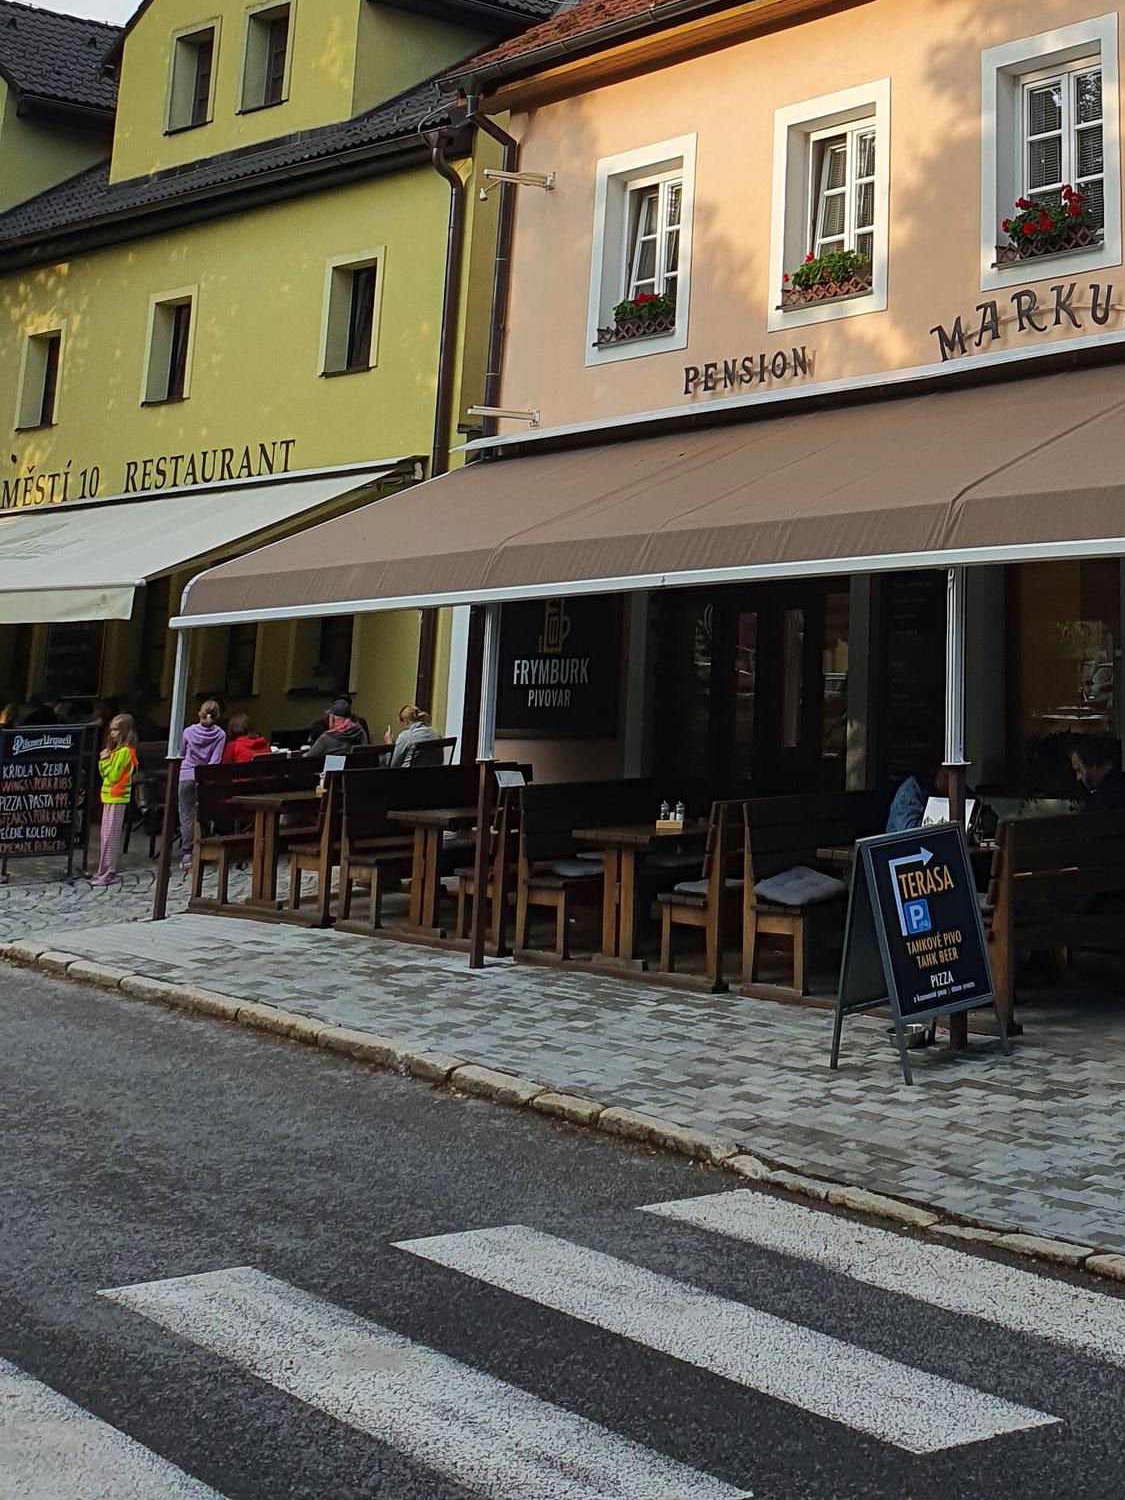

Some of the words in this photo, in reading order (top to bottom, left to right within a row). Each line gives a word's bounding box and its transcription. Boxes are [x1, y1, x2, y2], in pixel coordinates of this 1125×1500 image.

[684, 346, 807, 395] PENSION
[78, 466, 99, 500] 10
[122, 438, 296, 494] RESTAURANT
[513, 657, 590, 685] FRYMBURK
[528, 689, 571, 707] PIVOVAR
[43, 733, 73, 750] Urquell
[898, 864, 955, 900] TERASA
[906, 931, 943, 956] TANKOVÉ
[942, 929, 962, 947] PIVO
[916, 953, 938, 970] TANK
[939, 946, 959, 964] BEER
[930, 970, 955, 989] PIZZA
